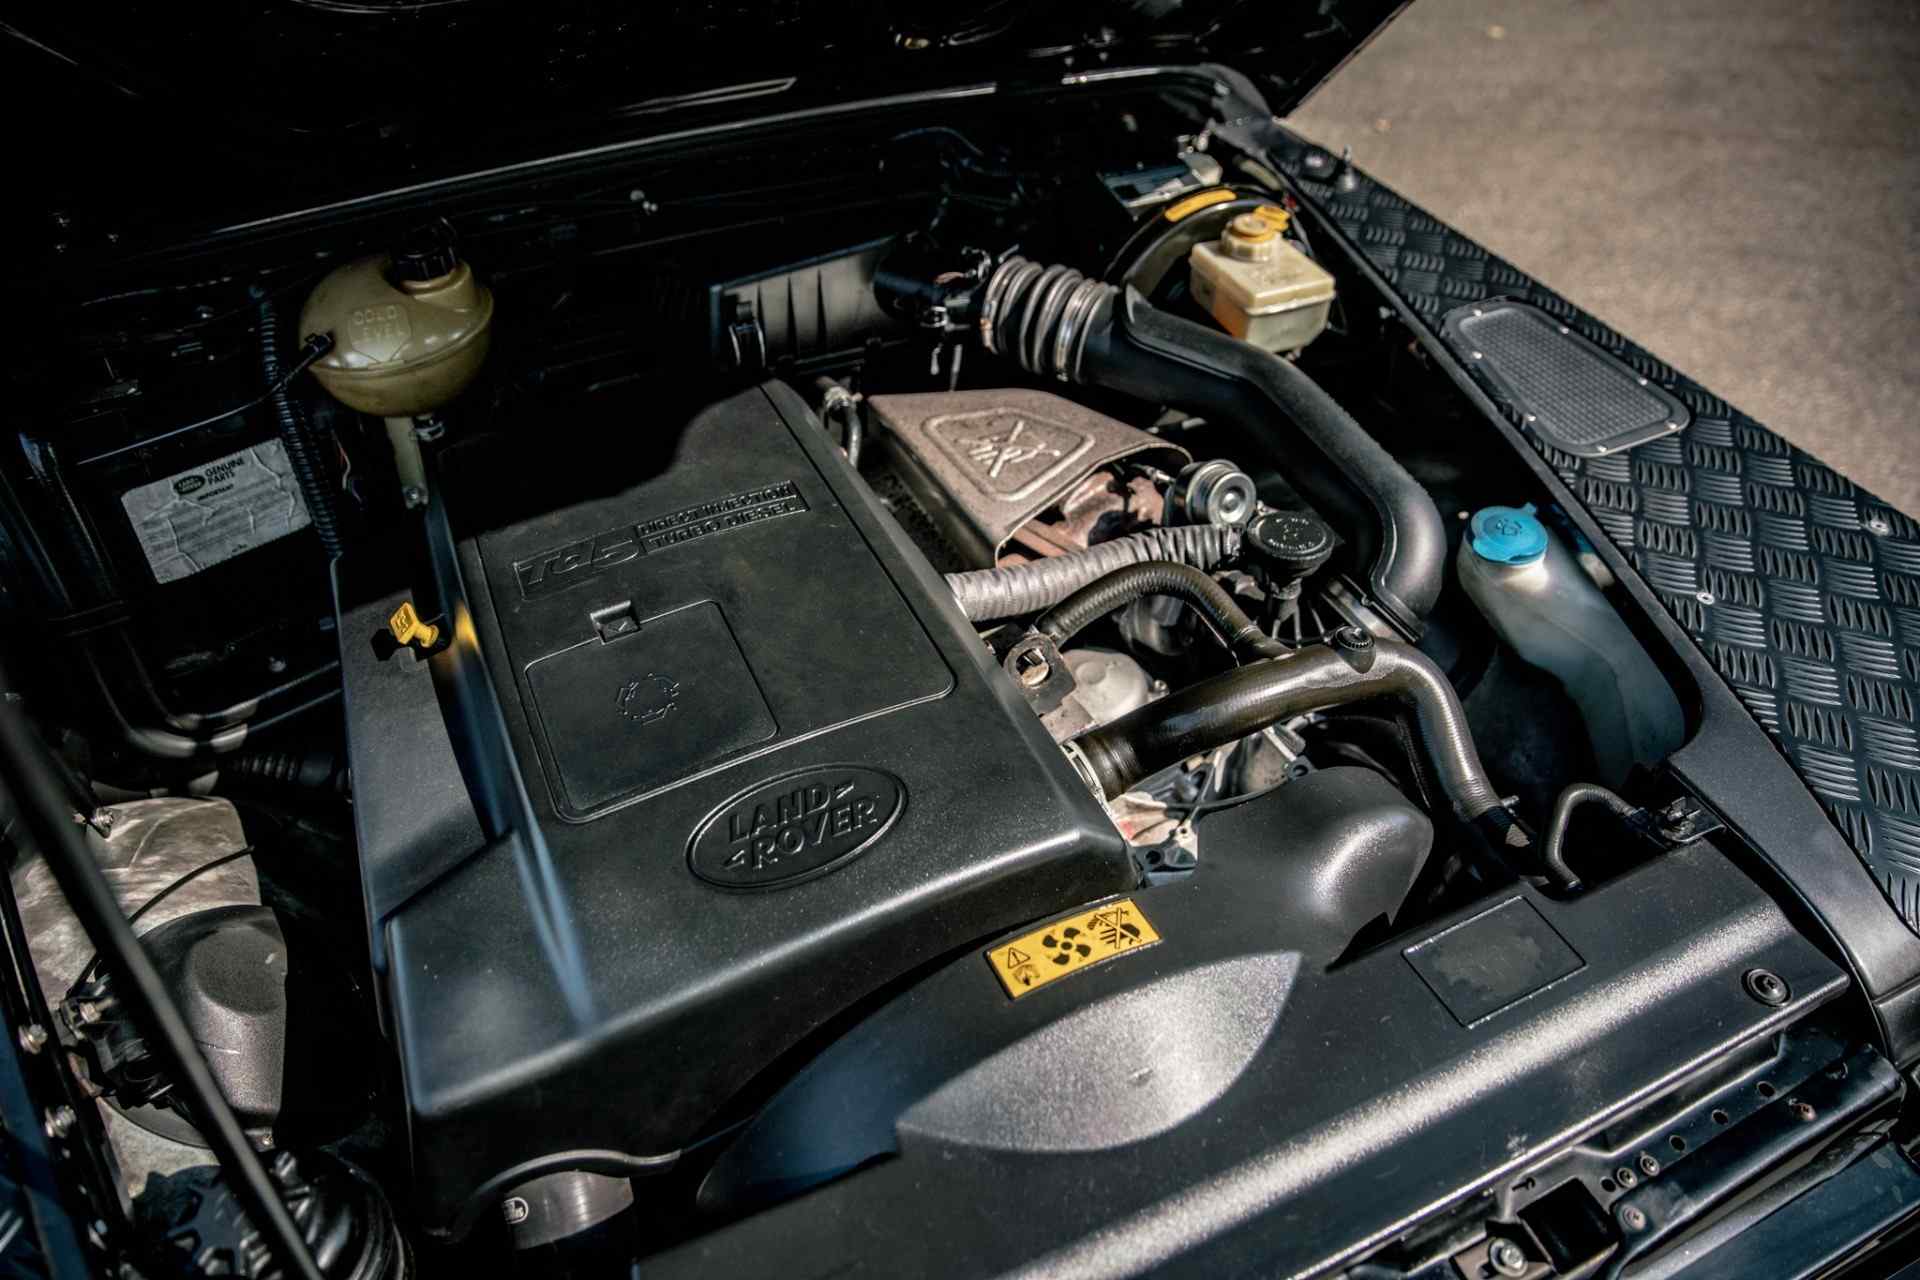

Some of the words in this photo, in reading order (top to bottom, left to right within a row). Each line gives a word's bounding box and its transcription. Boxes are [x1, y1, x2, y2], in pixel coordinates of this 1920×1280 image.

[205, 458, 244, 477] GENUINE
[207, 469, 236, 485] PARTS
[637, 508, 698, 537] DIRECT
[700, 484, 794, 516] INJECTION
[649, 519, 721, 548] TURBO
[722, 501, 797, 526] DIESEL
[518, 536, 640, 585] Td5
[729, 783, 832, 844] LAND
[751, 796, 879, 869] ROVER
